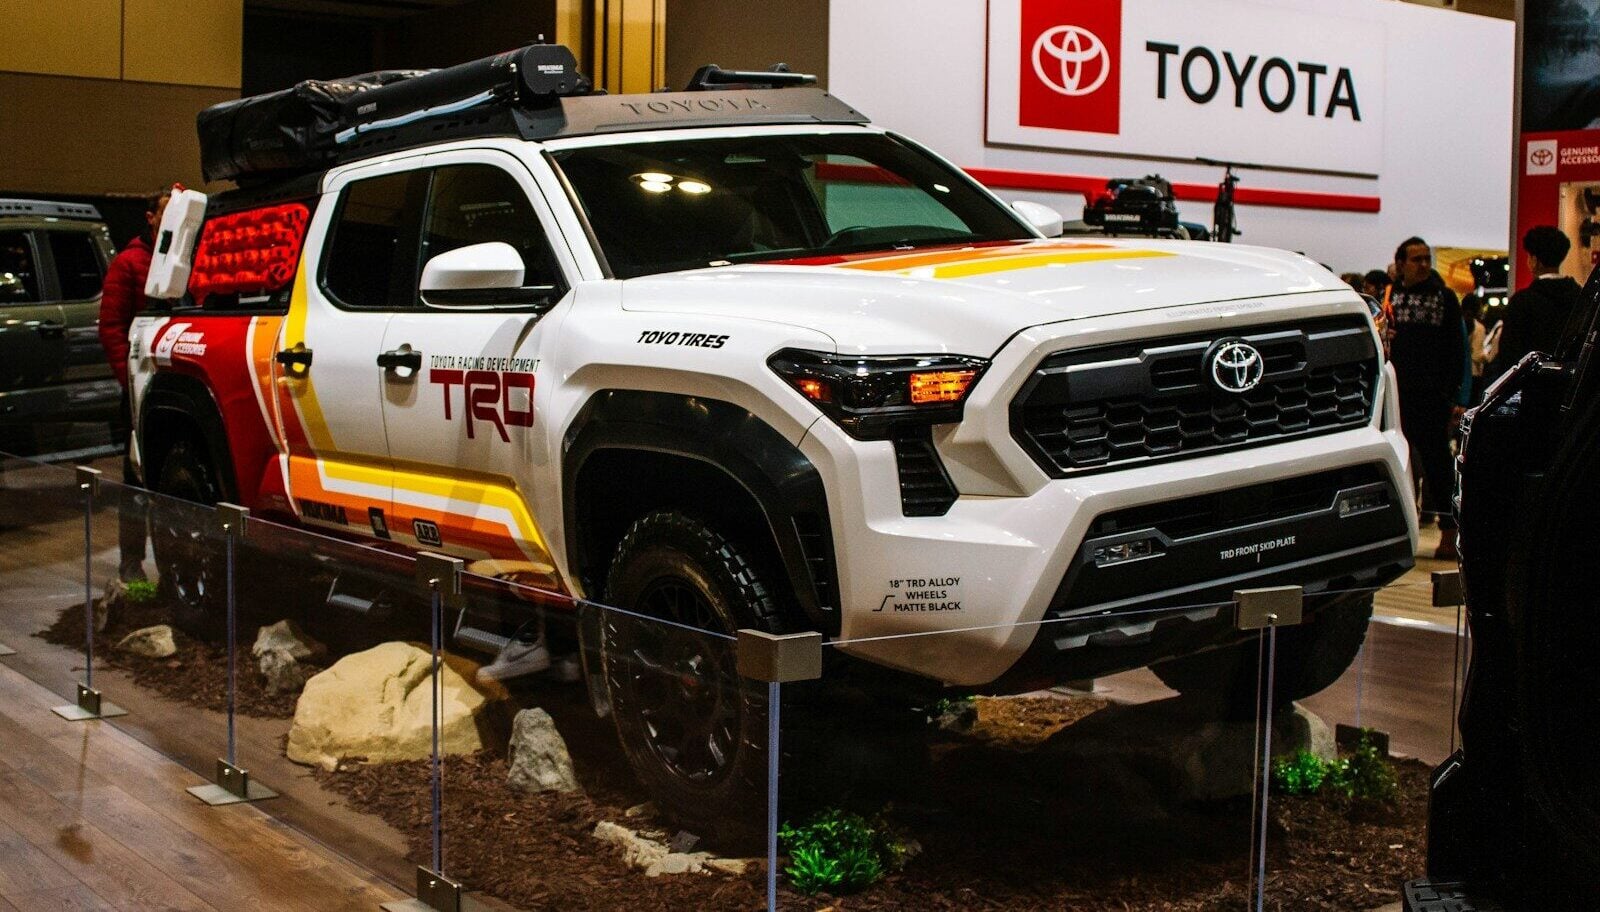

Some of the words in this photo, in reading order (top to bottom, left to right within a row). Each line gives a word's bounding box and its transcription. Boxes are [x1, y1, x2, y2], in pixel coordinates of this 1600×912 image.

[1145, 40, 1362, 122] TOYOTA
[620, 97, 770, 115] TOYOTA
[1560, 146, 1599, 156] GENUINE
[1560, 155, 1600, 165] ACCESSO
[636, 330, 680, 345] TOYO
[677, 332, 730, 349] TIRES
[430, 355, 456, 368] TOYOTA
[458, 356, 485, 370] RACING
[486, 357, 541, 373] DEVELOPMENT
[429, 369, 535, 443] TRD
[1220, 549, 1235, 560] TRD
[1235, 543, 1259, 557] FRONT
[1259, 540, 1276, 552] SKID
[1276, 535, 1296, 547] PLATE
[906, 579, 926, 588] TRD
[928, 577, 960, 587] ALLOY
[905, 590, 947, 600] WHEELS
[894, 603, 926, 612] MATTE
[928, 601, 961, 611] BLACK
